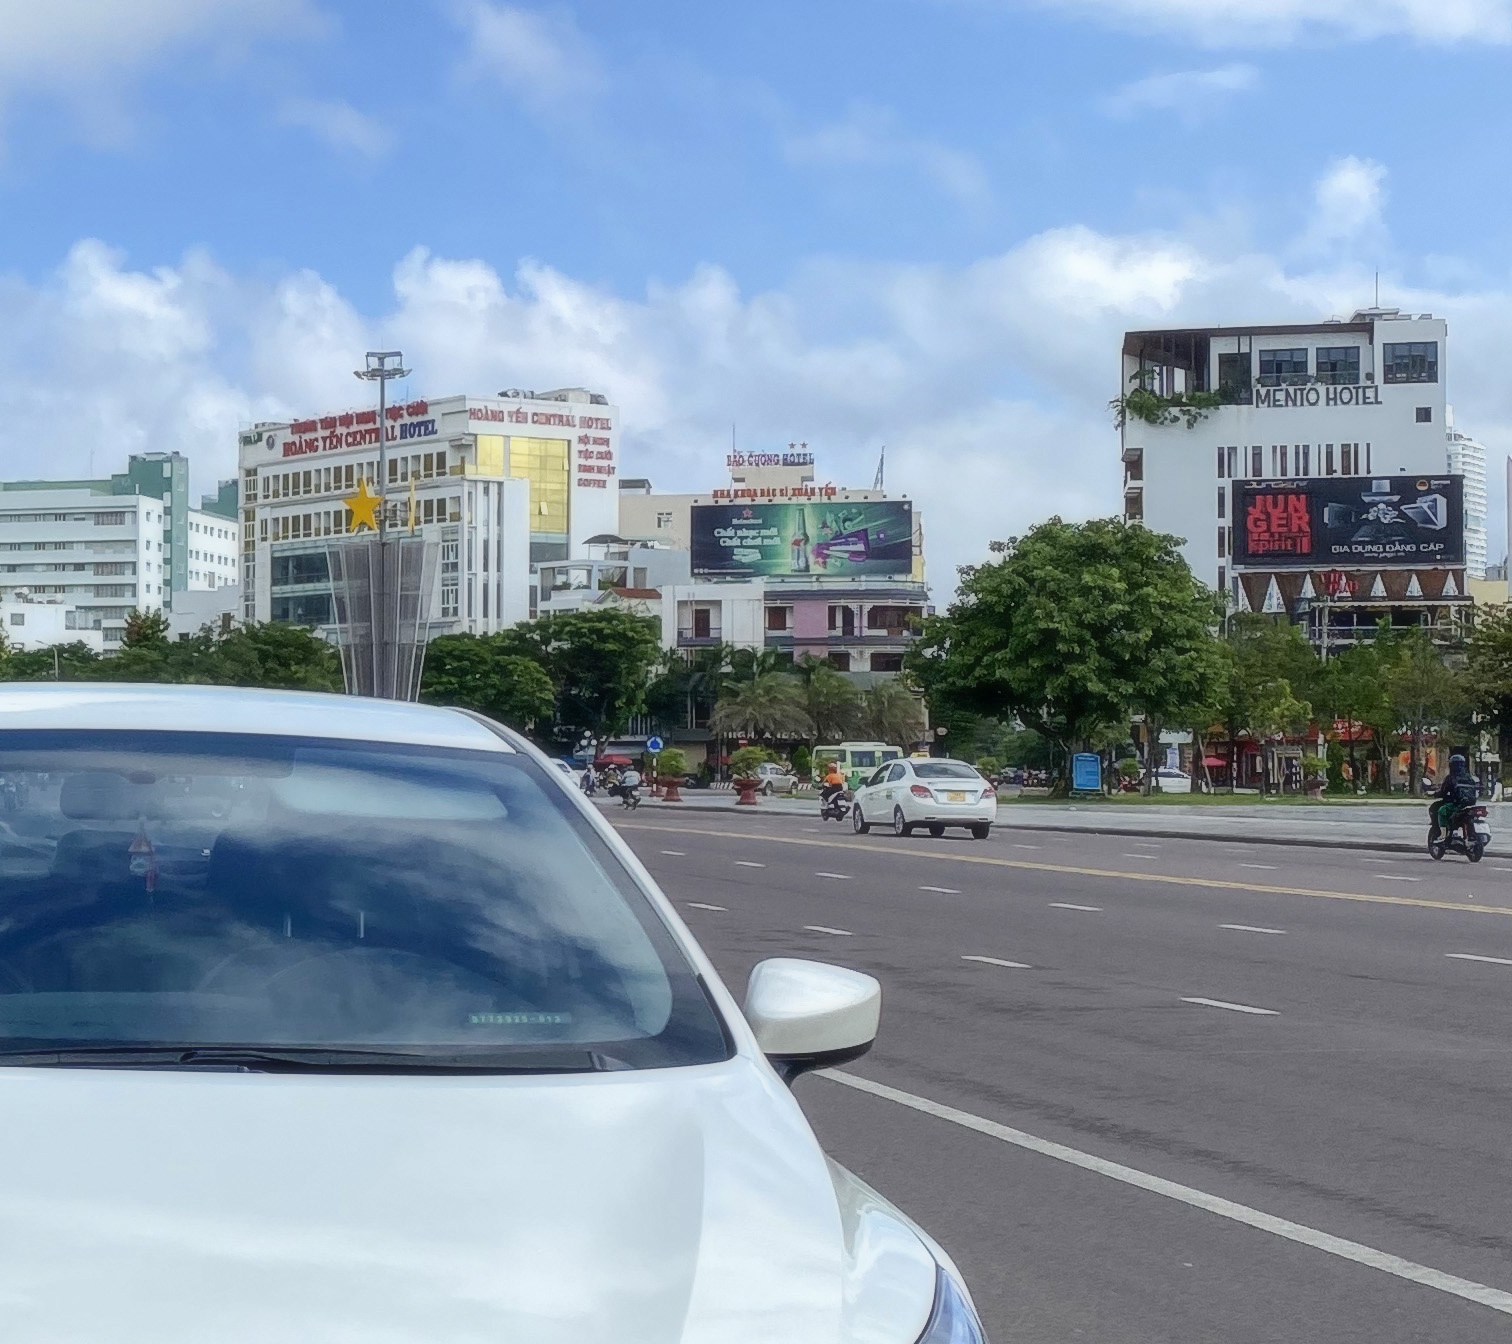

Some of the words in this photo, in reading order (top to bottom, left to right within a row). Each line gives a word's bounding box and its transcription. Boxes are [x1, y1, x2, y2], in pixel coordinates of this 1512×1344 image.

[1255, 386, 1320, 408] MENTO
[1325, 385, 1382, 406] HOTEL
[468, 405, 504, 422] HOÀNG
[507, 407, 528, 424] YẾN
[531, 411, 576, 428] CENTRAL
[579, 416, 612, 430] HOTEL
[282, 432, 319, 457] HOÀNG
[320, 426, 343, 451] YẾN
[399, 419, 437, 440] HOTEL
[782, 452, 814, 465] HOTEL
[577, 478, 607, 488] COFFEE
[712, 489, 732, 498] NHA
[733, 488, 758, 498] KHOA
[1247, 494, 1307, 513] JUN
[1246, 512, 1311, 532] GER
[1331, 545, 1350, 553] GIA
